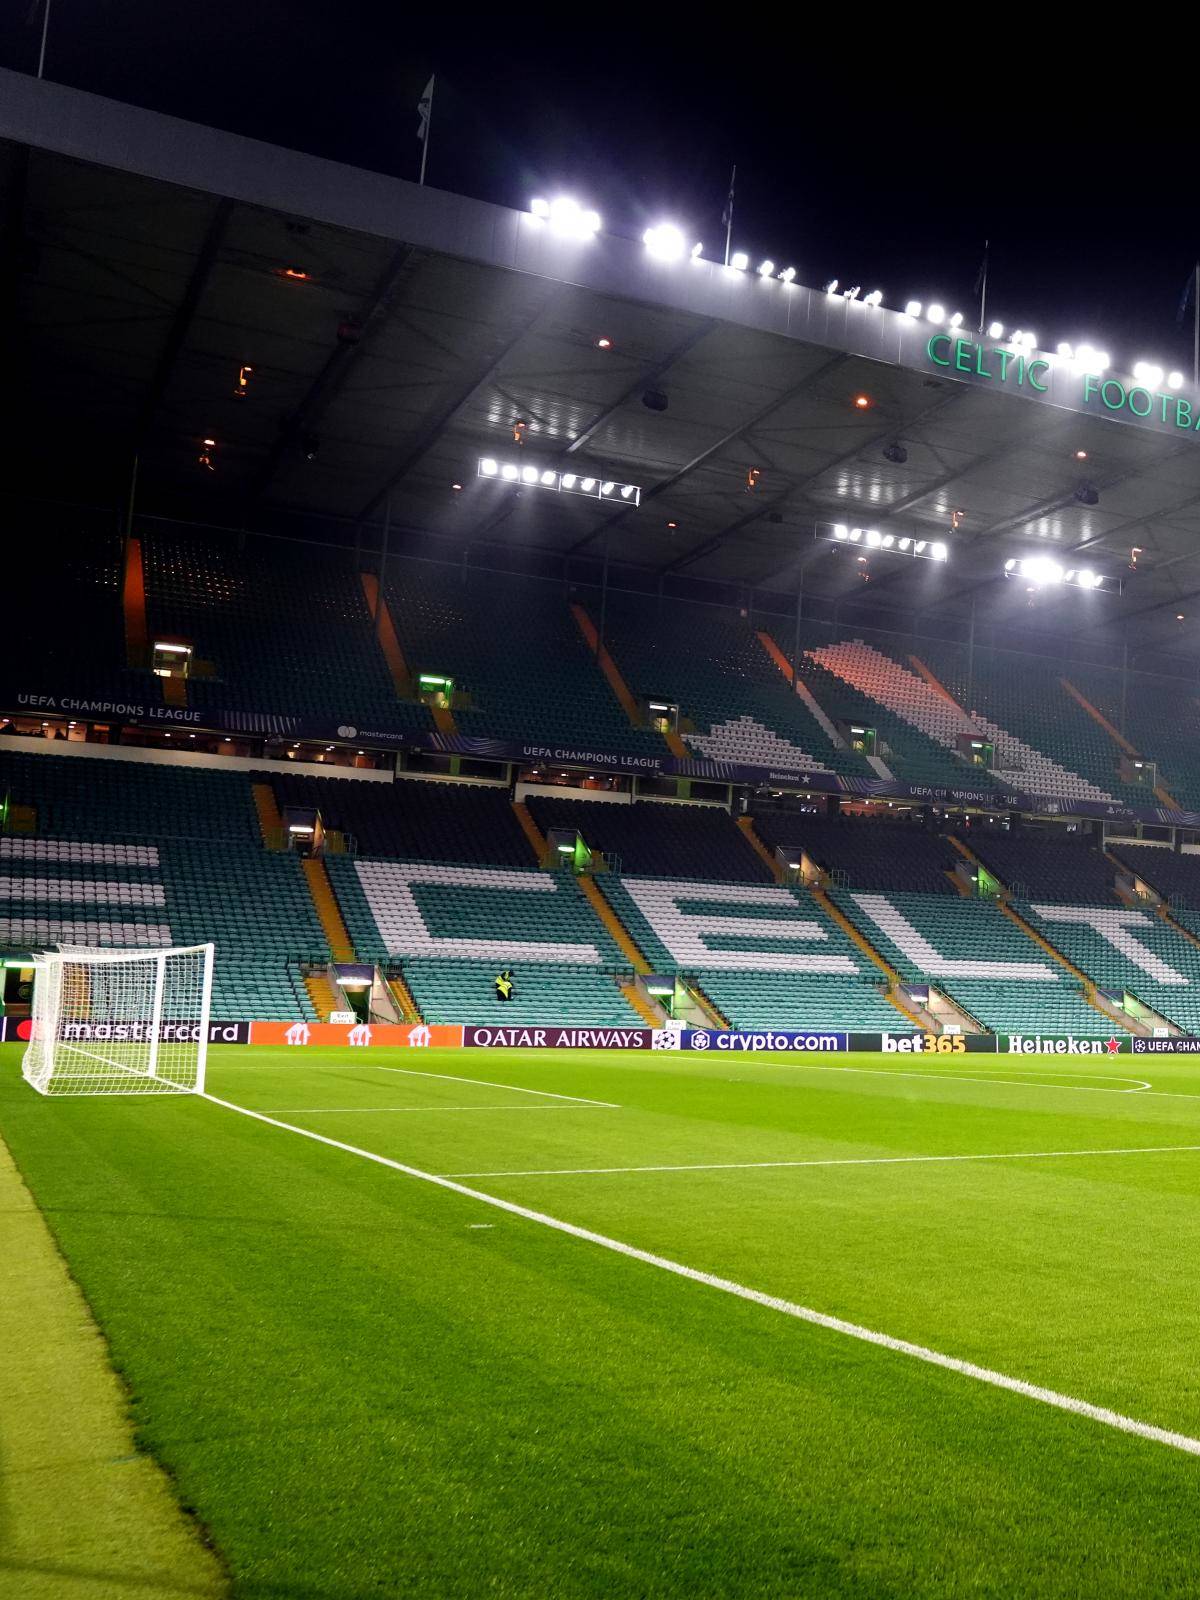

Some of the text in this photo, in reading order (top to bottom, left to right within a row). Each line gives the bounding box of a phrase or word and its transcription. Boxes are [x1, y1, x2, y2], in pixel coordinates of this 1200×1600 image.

[928, 335, 1049, 391] CELTIC
[17, 693, 201, 721] UEFA CHAMPIONS LEAGUE
[360, 730, 403, 740] mastercard
[523, 745, 661, 768] UEFA CHAMPIONS LEAGUE
[910, 786, 1017, 804] UEFA CHMPIONS LEUE
[474, 1029, 643, 1047] QATAR AIRWAYS
[717, 1032, 837, 1051] crypto.com
[881, 1033, 966, 1053] bet365
[1008, 1035, 1103, 1053] Heineken
[1148, 1041, 1174, 1051] UEFA
